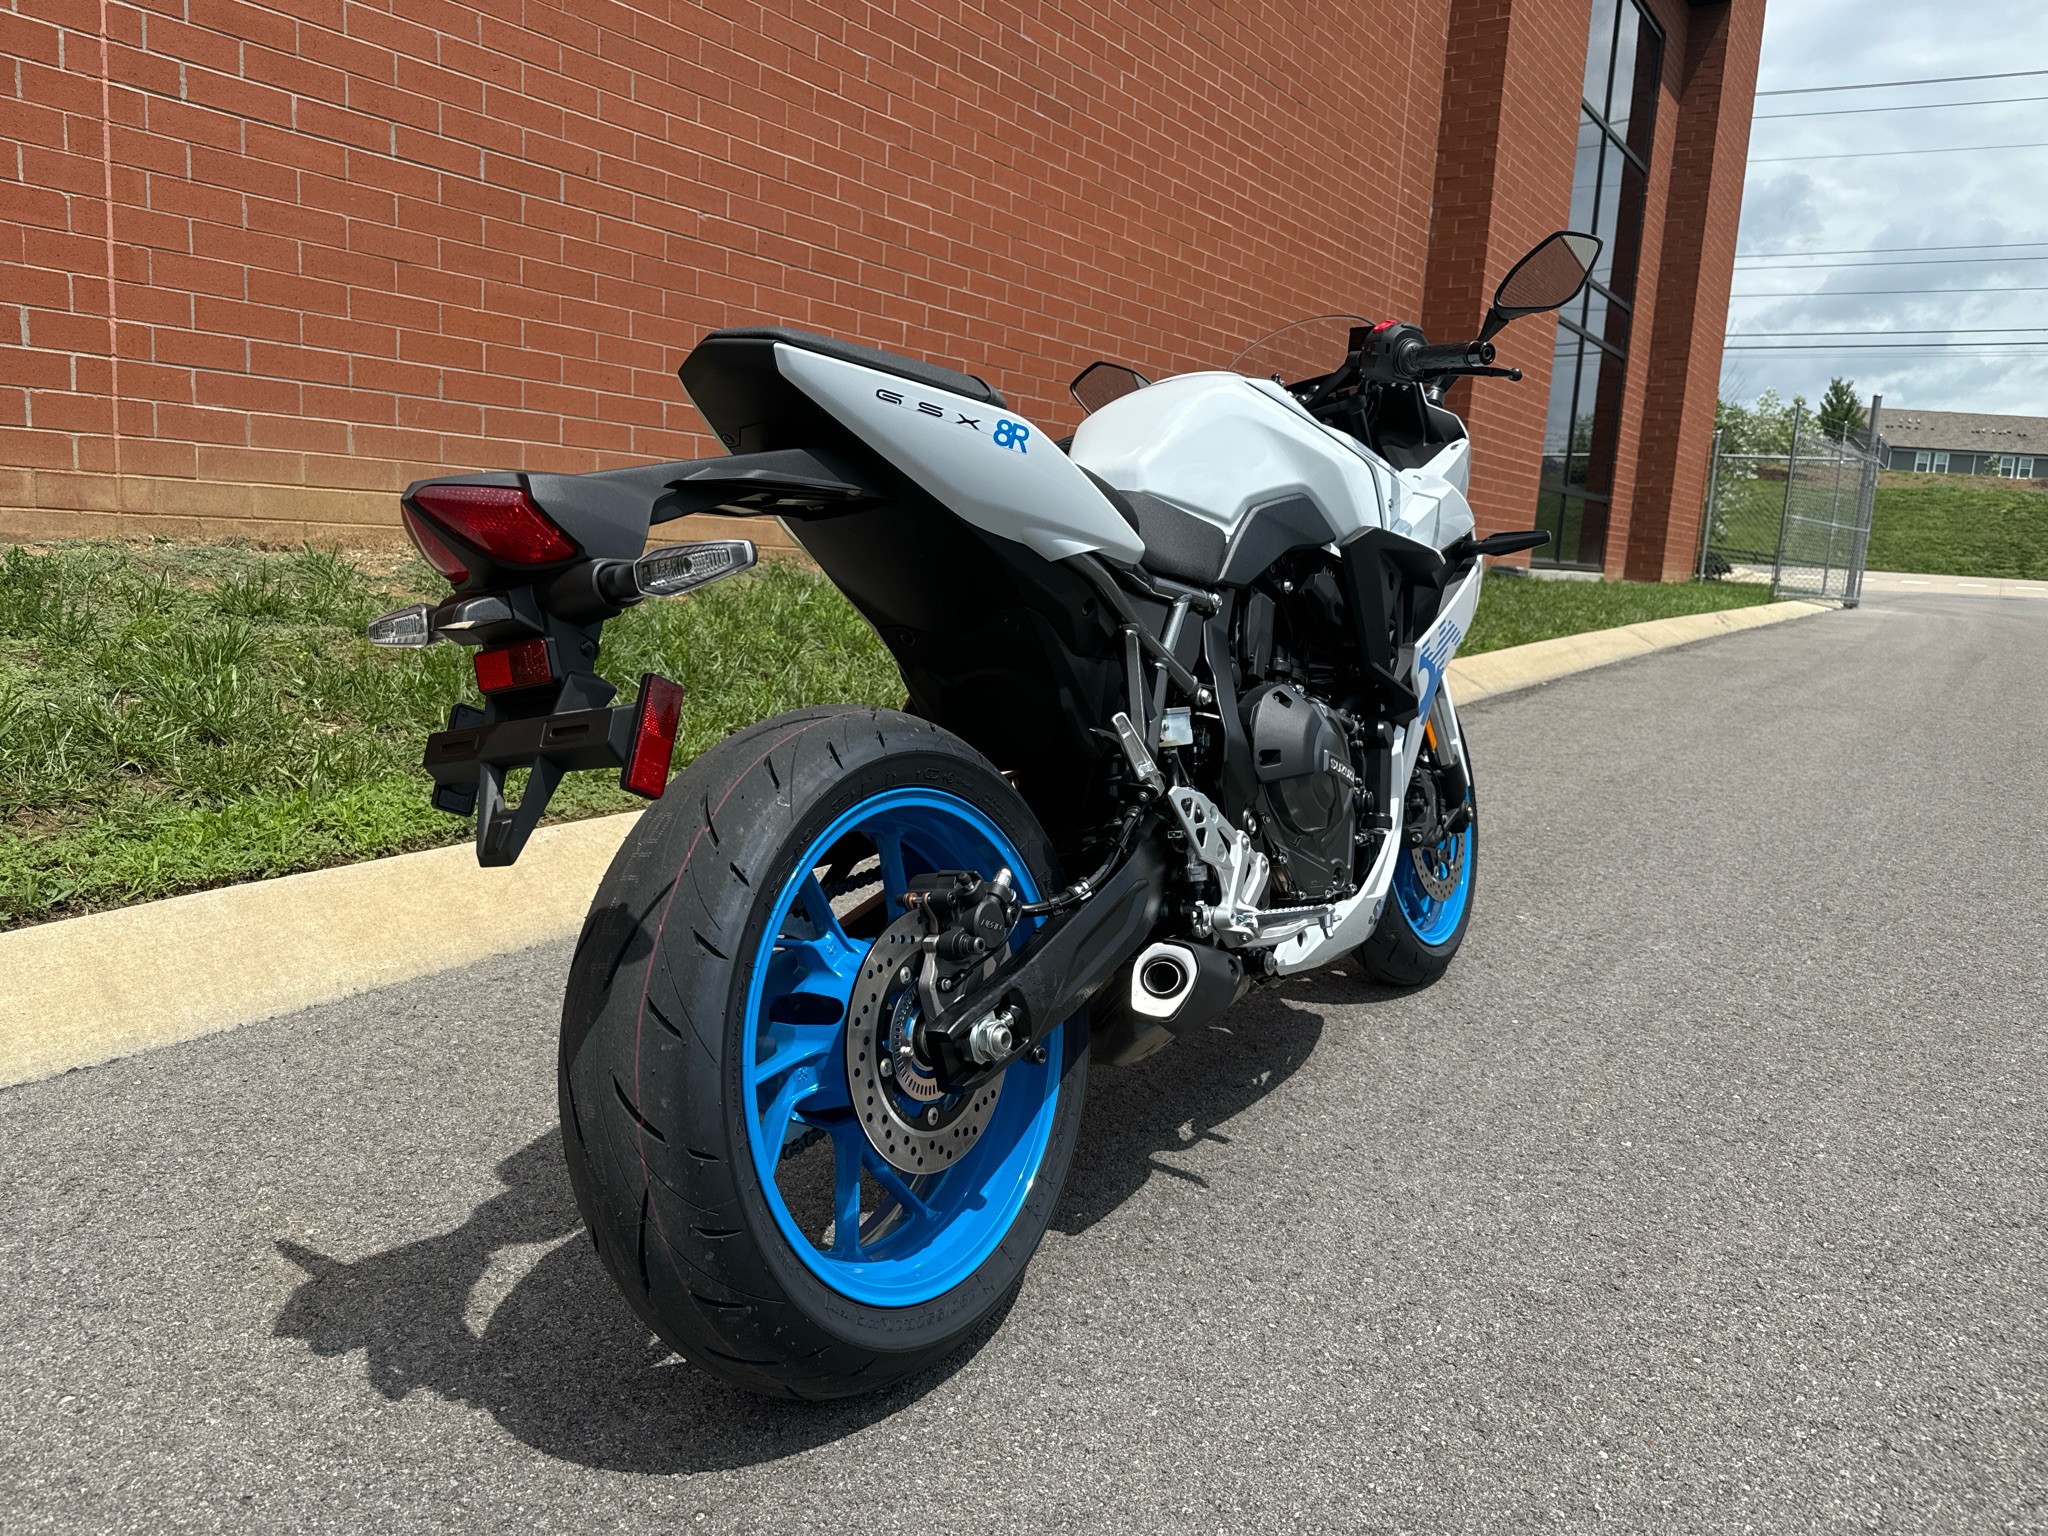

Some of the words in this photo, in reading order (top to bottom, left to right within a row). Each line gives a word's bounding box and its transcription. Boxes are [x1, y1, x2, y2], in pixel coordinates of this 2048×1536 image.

[875, 389, 981, 430] GSX
[993, 419, 1030, 454] 8R
[1329, 758, 1355, 783] SUZUKI
